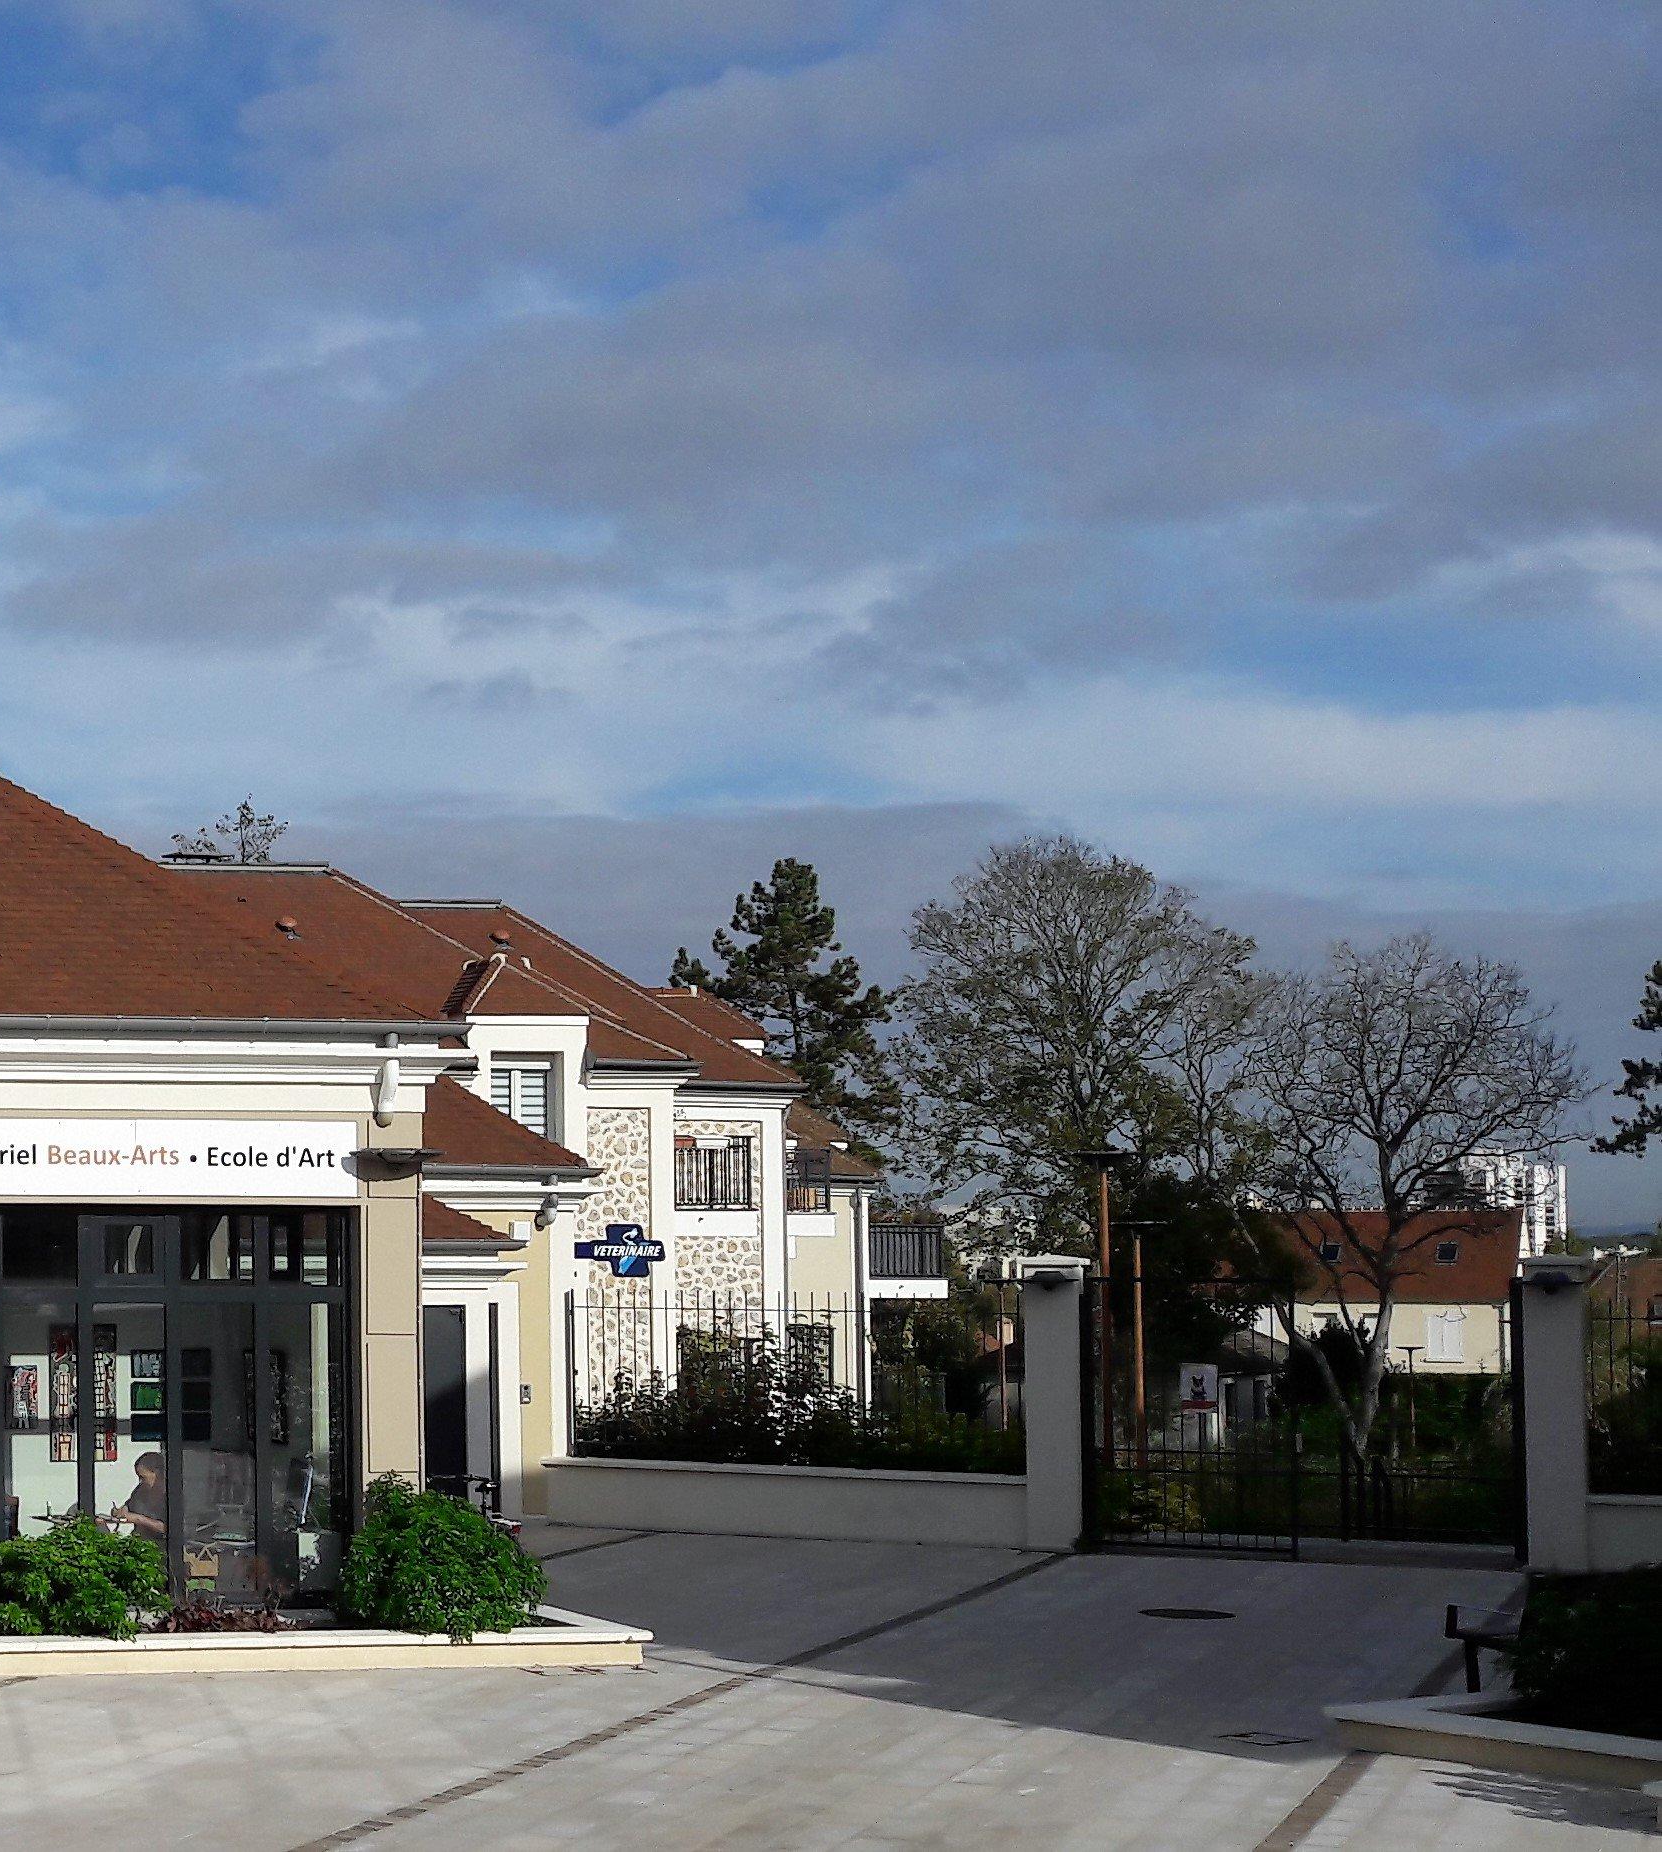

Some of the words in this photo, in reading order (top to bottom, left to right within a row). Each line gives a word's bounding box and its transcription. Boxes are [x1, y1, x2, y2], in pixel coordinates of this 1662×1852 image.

[47, 1144, 180, 1166] Beaux-Arts
[207, 1145, 269, 1168] Ecole
[276, 1145, 336, 1168] d'Art
[593, 1245, 662, 1257] VETERINAIRE
